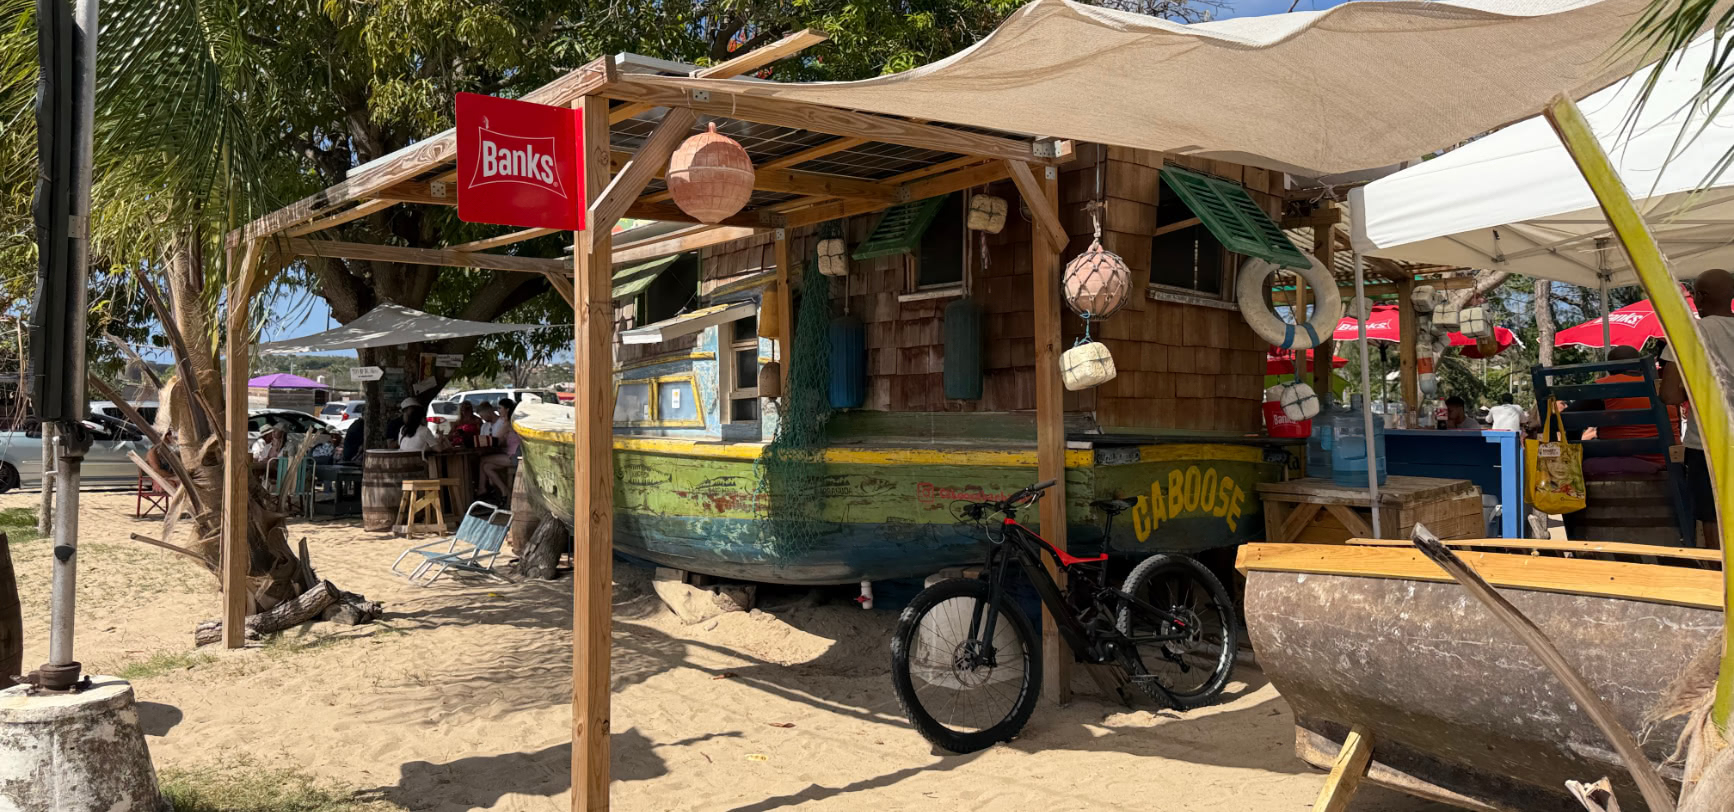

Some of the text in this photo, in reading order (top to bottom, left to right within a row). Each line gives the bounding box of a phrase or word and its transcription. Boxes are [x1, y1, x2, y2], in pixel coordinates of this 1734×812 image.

[482, 140, 554, 185] Banks
[1336, 321, 1387, 331] Baks
[1131, 465, 1246, 543] CABOOSE
